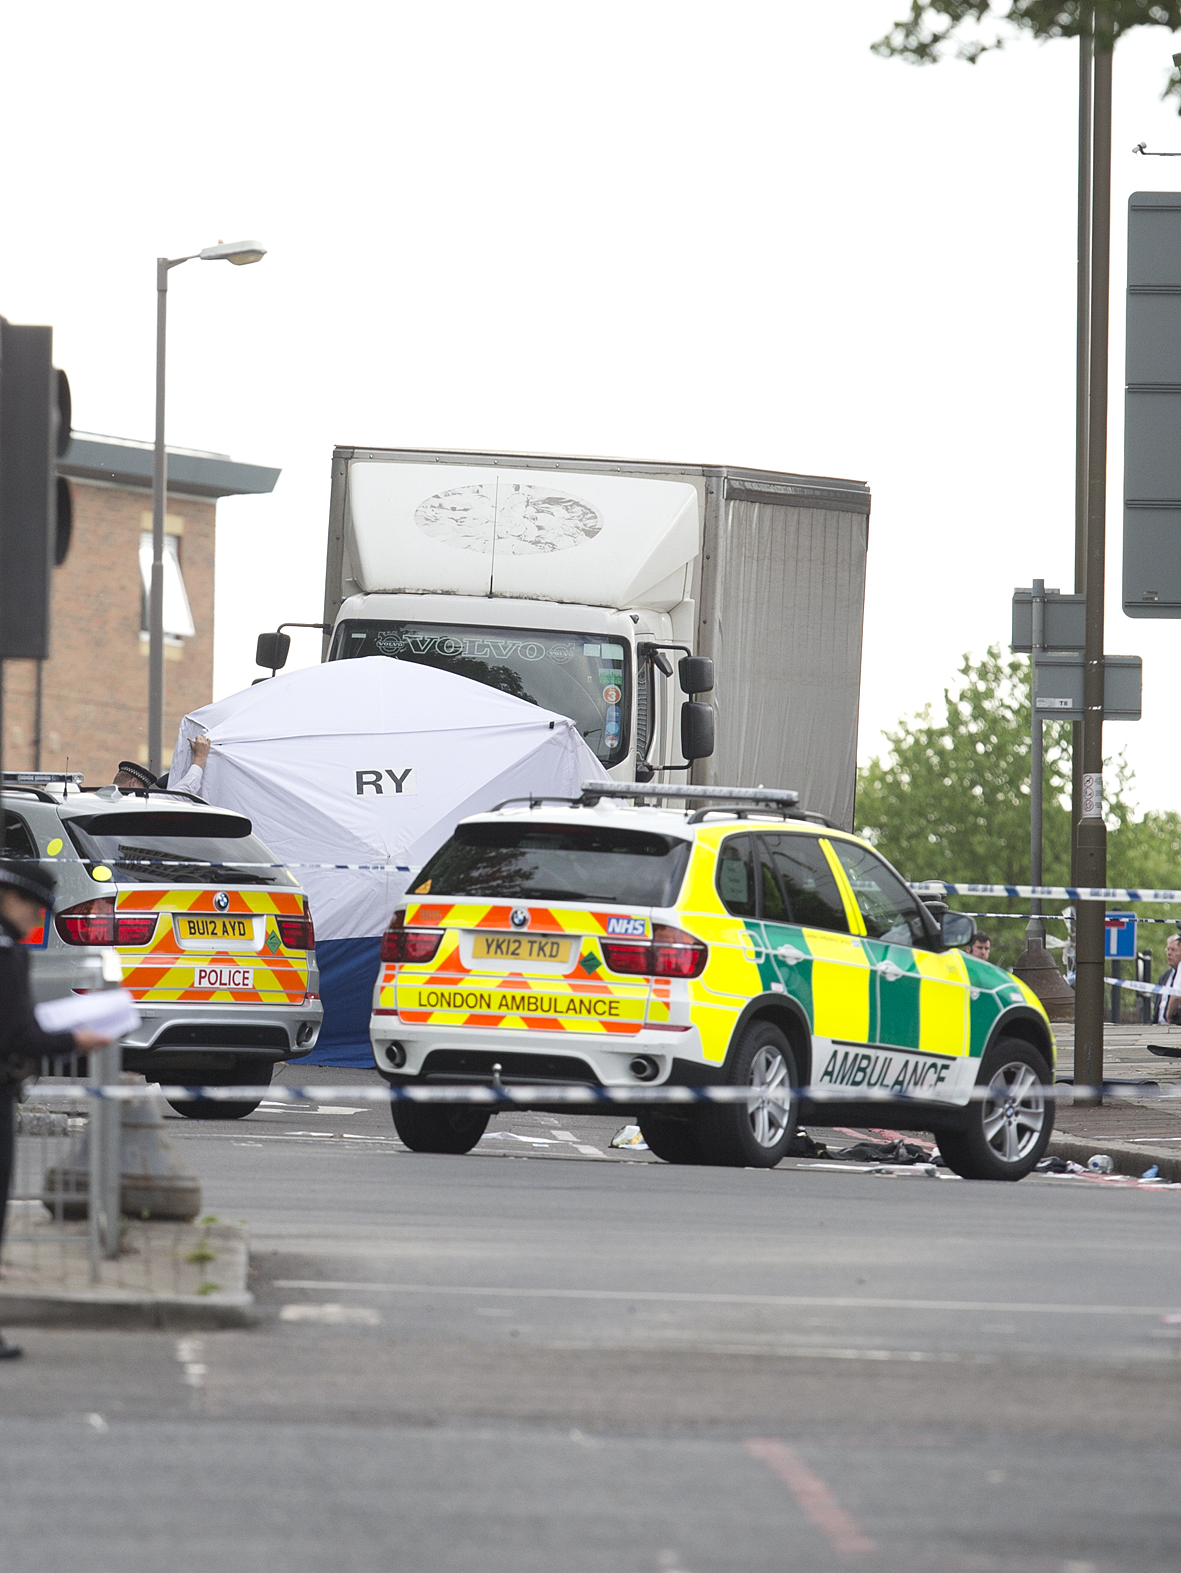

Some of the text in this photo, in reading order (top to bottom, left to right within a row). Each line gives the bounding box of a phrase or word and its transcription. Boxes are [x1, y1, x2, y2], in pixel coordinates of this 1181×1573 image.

[402, 635, 546, 661] VOLVO
[355, 768, 413, 795] RY
[187, 920, 246, 937] BU12 AYD
[608, 917, 645, 935] NHS
[485, 938, 560, 958] YK12 TKD
[198, 969, 250, 986] POLICE
[418, 991, 621, 1017] LONDON AMBULANCE
[819, 1049, 951, 1093] AMBULANCE
